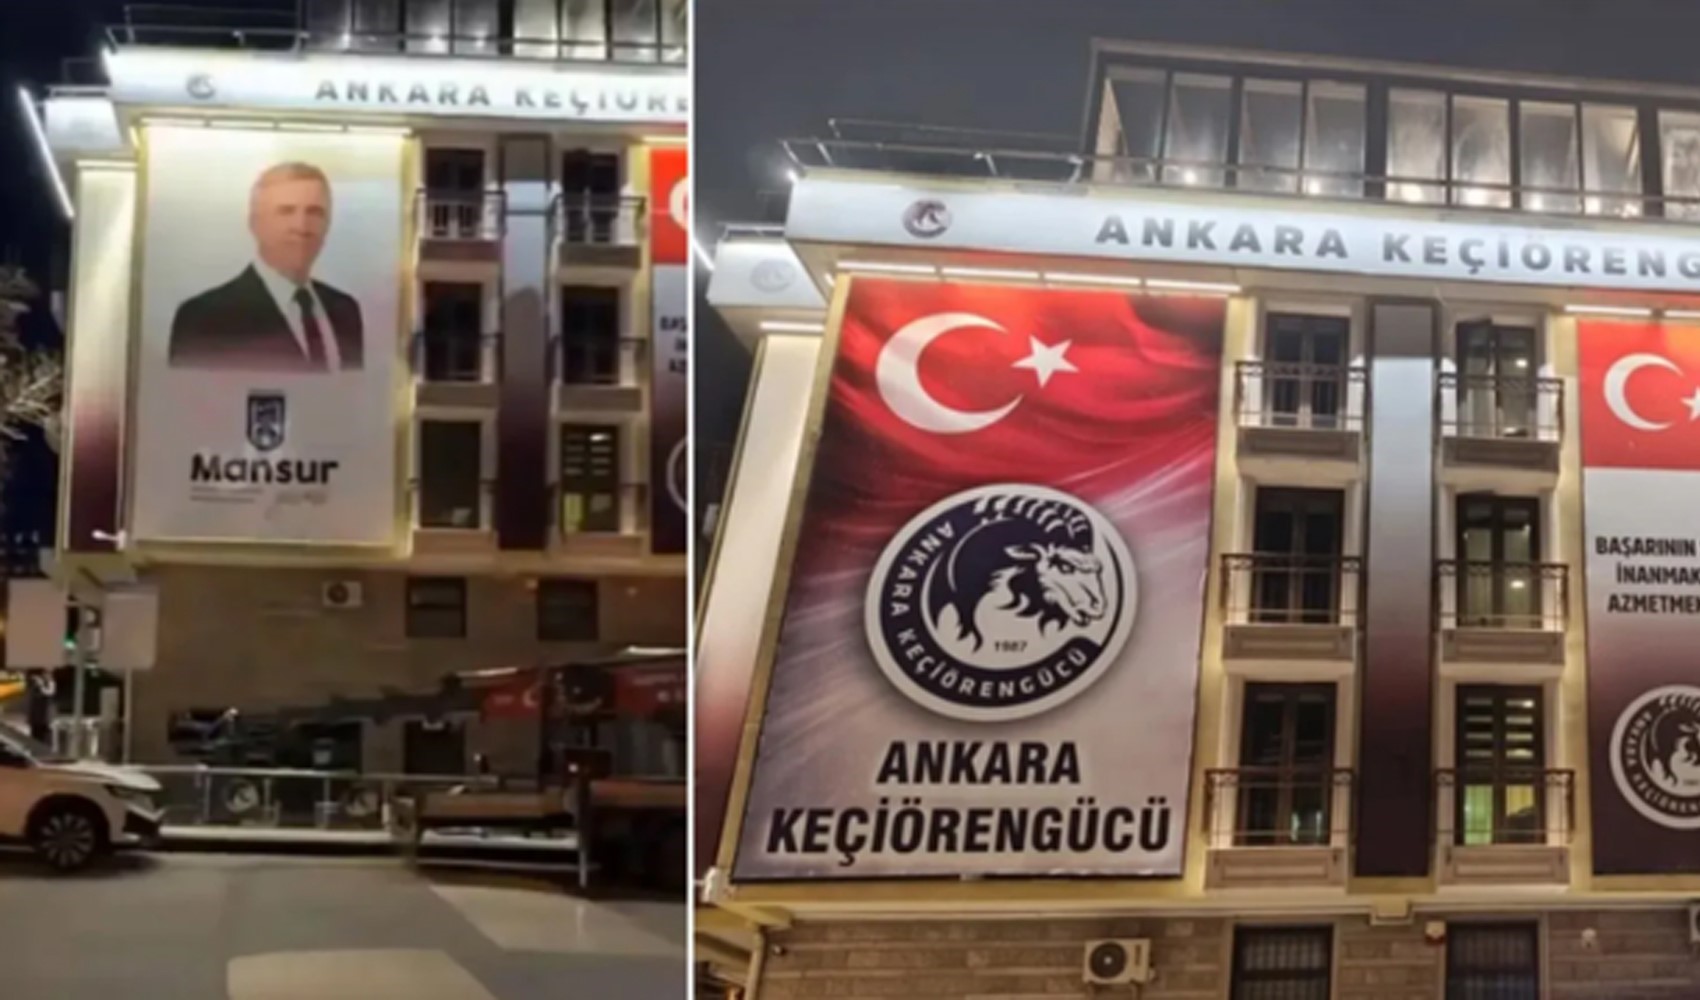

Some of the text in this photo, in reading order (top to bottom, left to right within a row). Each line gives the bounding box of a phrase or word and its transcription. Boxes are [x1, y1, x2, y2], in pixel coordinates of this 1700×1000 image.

[315, 79, 491, 107] ANKARA
[1095, 214, 1349, 259] ANKARA
[190, 453, 339, 484] Mansur
[1596, 536, 1696, 557] BAŞARININ
[889, 521, 1087, 698] ANKARA KEÇİÖRENGÜCÜ
[993, 640, 1028, 653] 1987
[876, 741, 1081, 785] ANKARA
[766, 797, 1171, 867] KEÇİÖRENGÜCÜ
